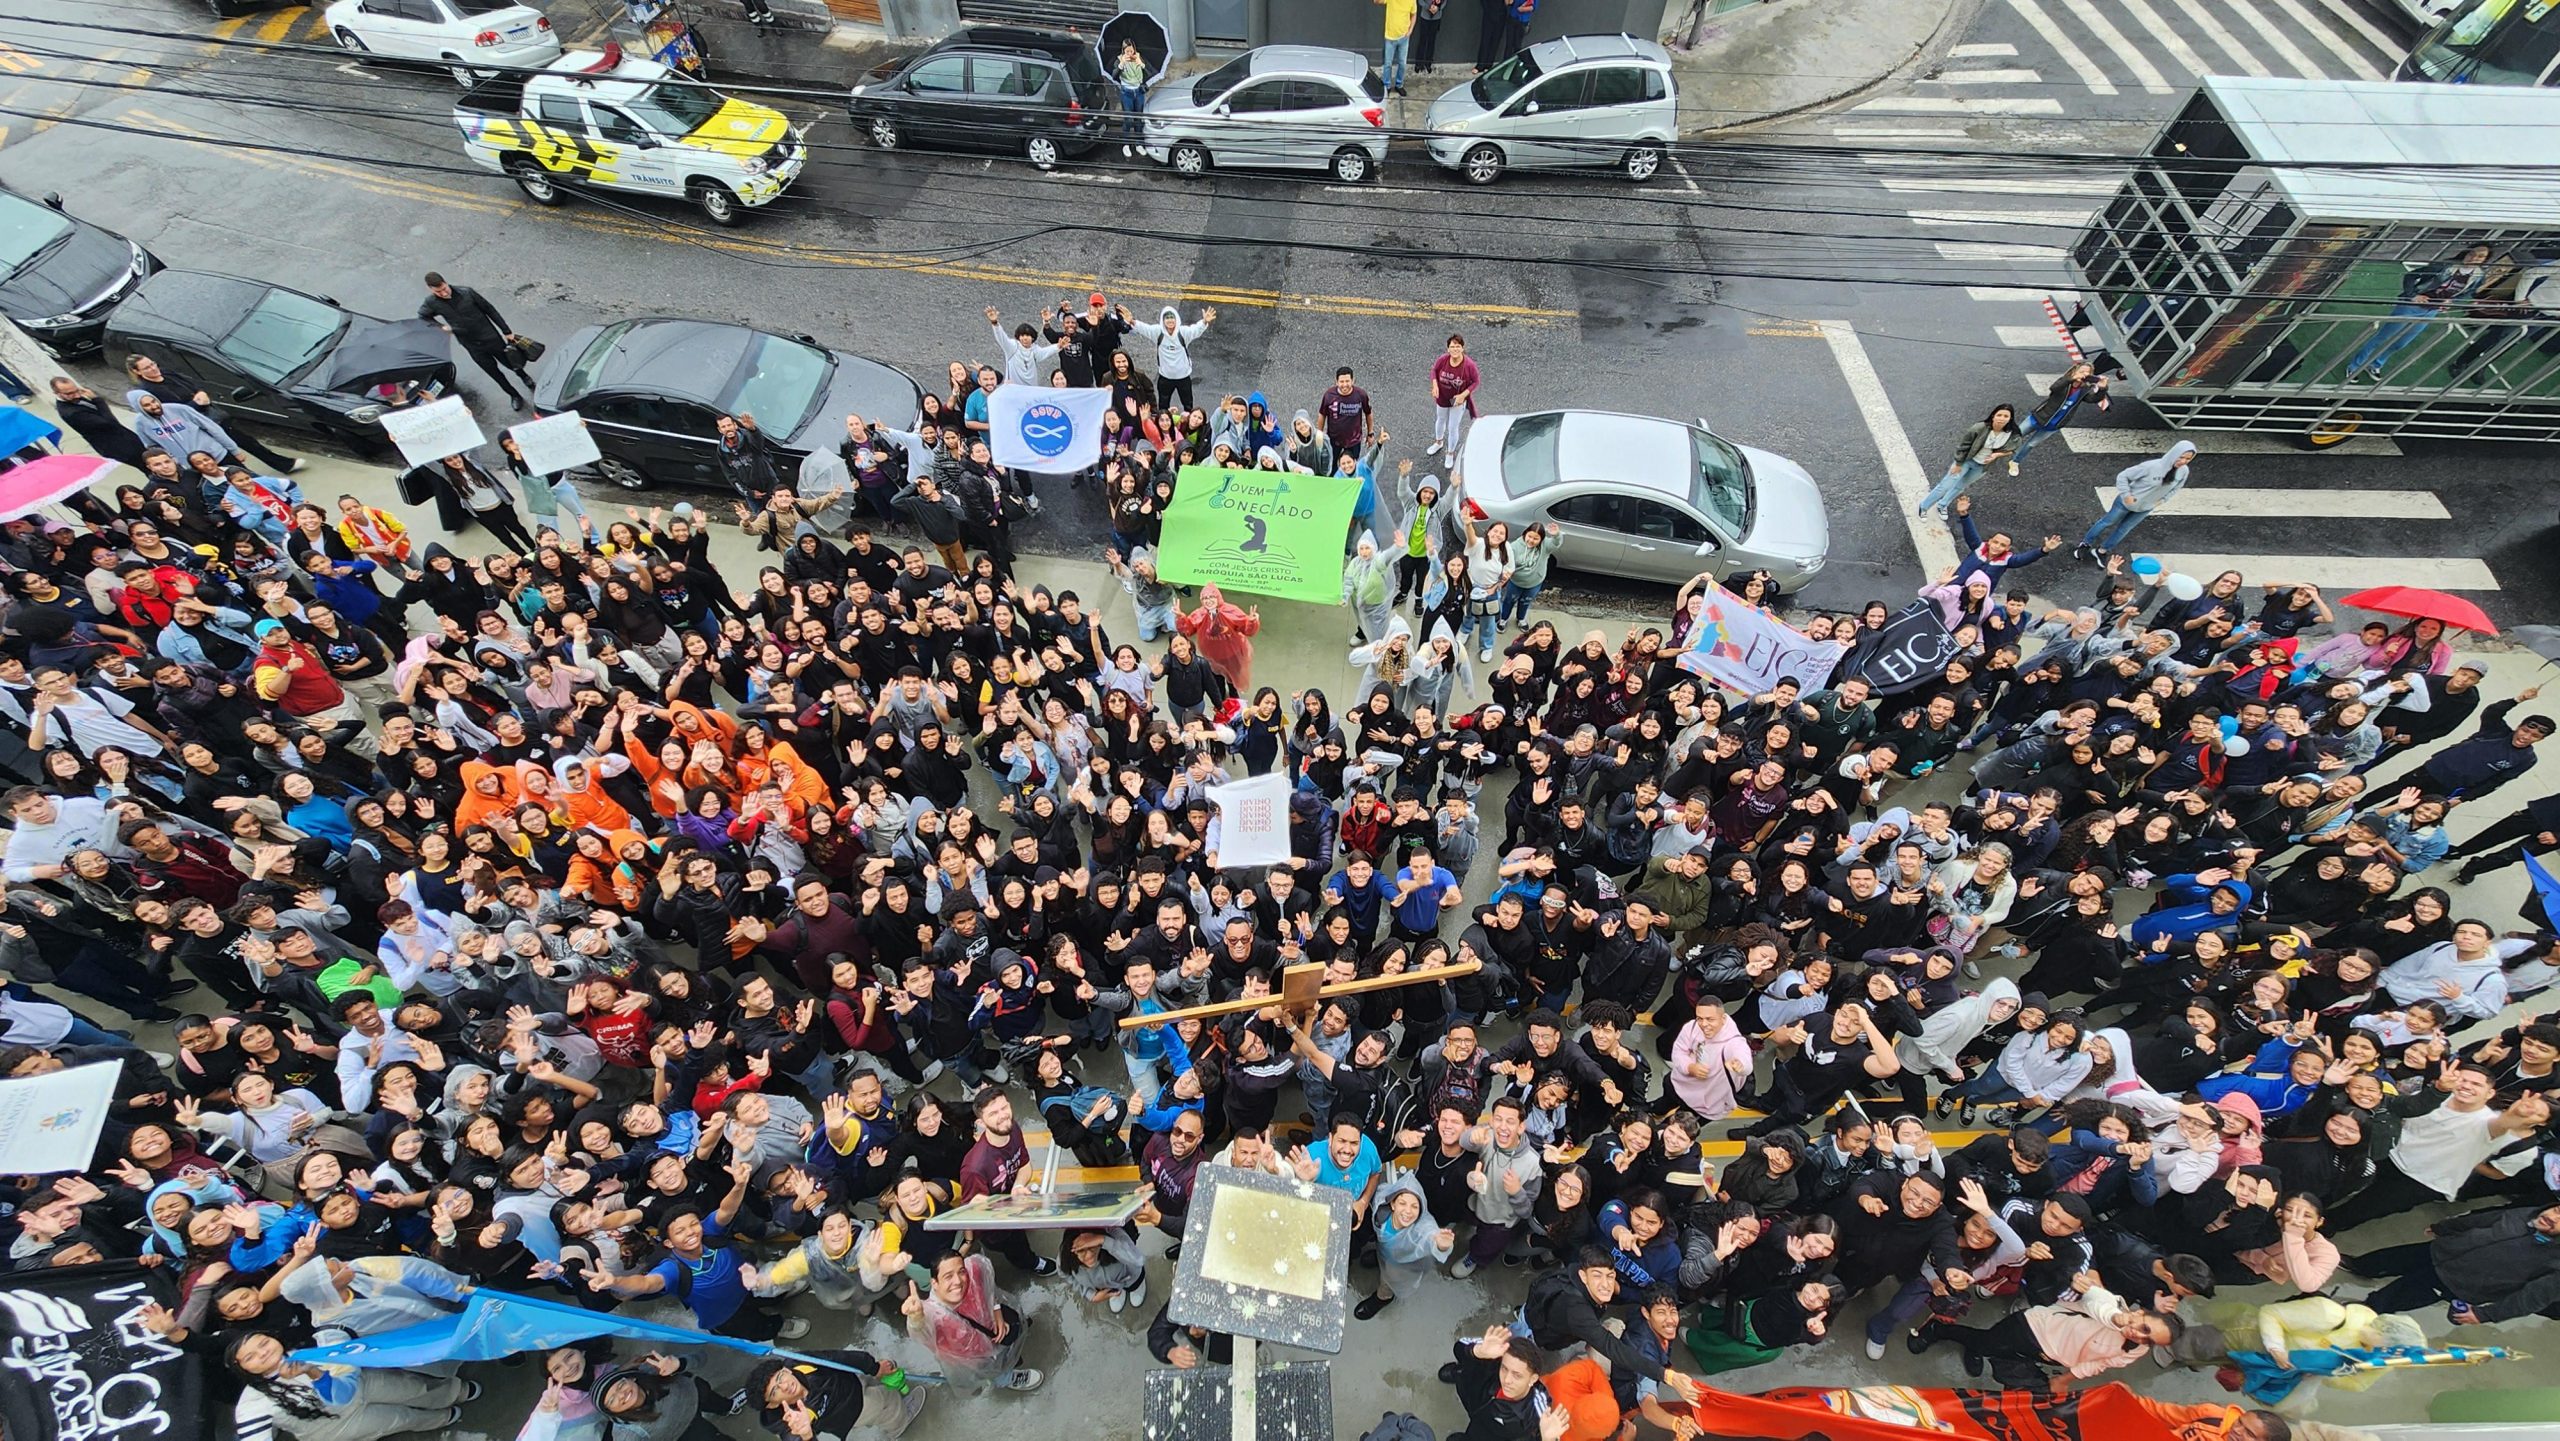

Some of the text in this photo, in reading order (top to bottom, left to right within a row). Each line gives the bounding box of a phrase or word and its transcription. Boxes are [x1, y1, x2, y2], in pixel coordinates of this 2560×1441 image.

[1030, 405, 1063, 419] SSVP
[1216, 474, 1265, 497] JOVEM
[1208, 489, 1313, 520] CONECTADO
[1192, 567, 1304, 583] PARÓQUIA SÃO LUCAS
[1209, 561, 1292, 575] COM JESUS CRISTO
[1743, 631, 1808, 681] EJC
[1878, 632, 1942, 684] EJC
[1239, 798, 1271, 806] DIVINO
[1239, 804, 1271, 812] DIVINO
[1239, 811, 1271, 819] DIVINO
[1239, 818, 1271, 826] DIVINO
[1238, 825, 1271, 833] DIVINO
[1841, 908, 1868, 924] OSS
[595, 1022, 634, 1034] CRISMA
[1193, 1291, 1218, 1306] 50W
[1297, 1311, 1323, 1328] IP66
